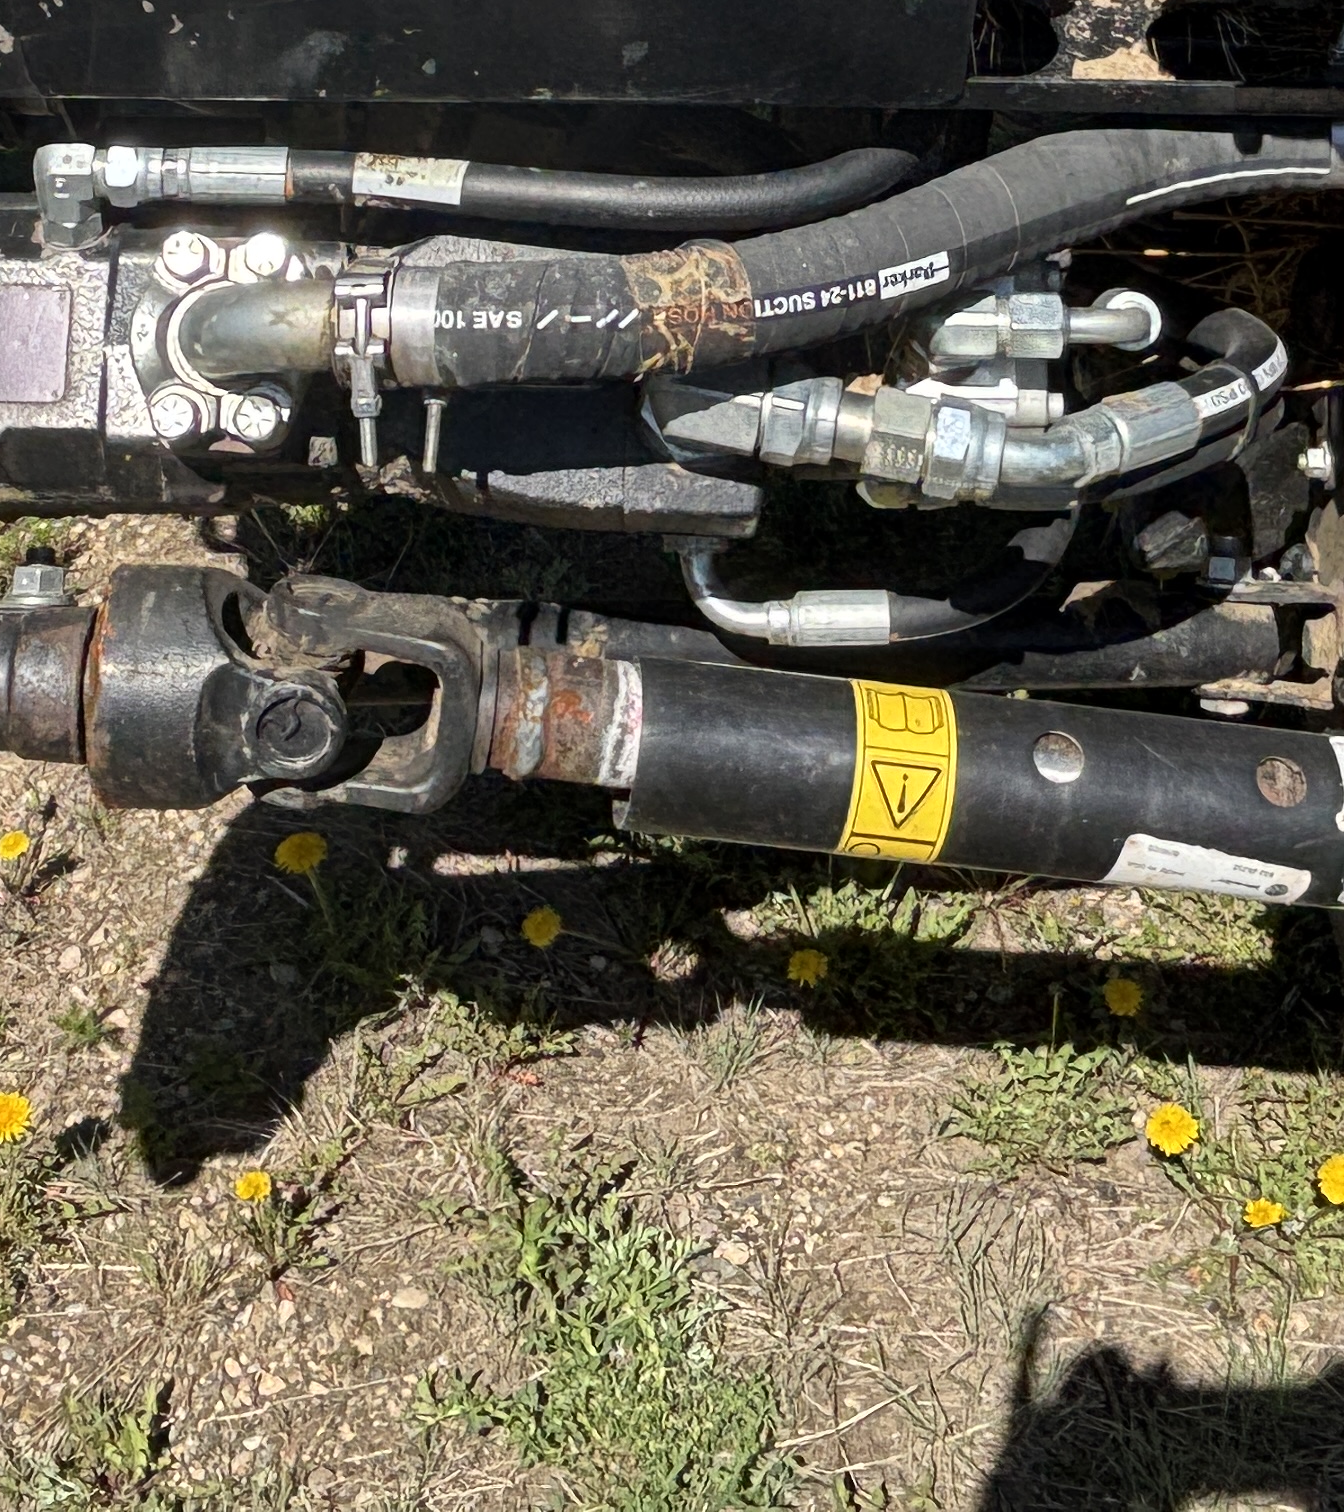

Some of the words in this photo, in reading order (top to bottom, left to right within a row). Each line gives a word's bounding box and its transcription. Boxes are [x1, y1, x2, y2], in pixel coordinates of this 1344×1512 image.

[882, 262, 937, 288] Parker
[730, 292, 817, 319] SUCTION
[822, 279, 877, 308] 811-24
[472, 310, 523, 329] SAE
